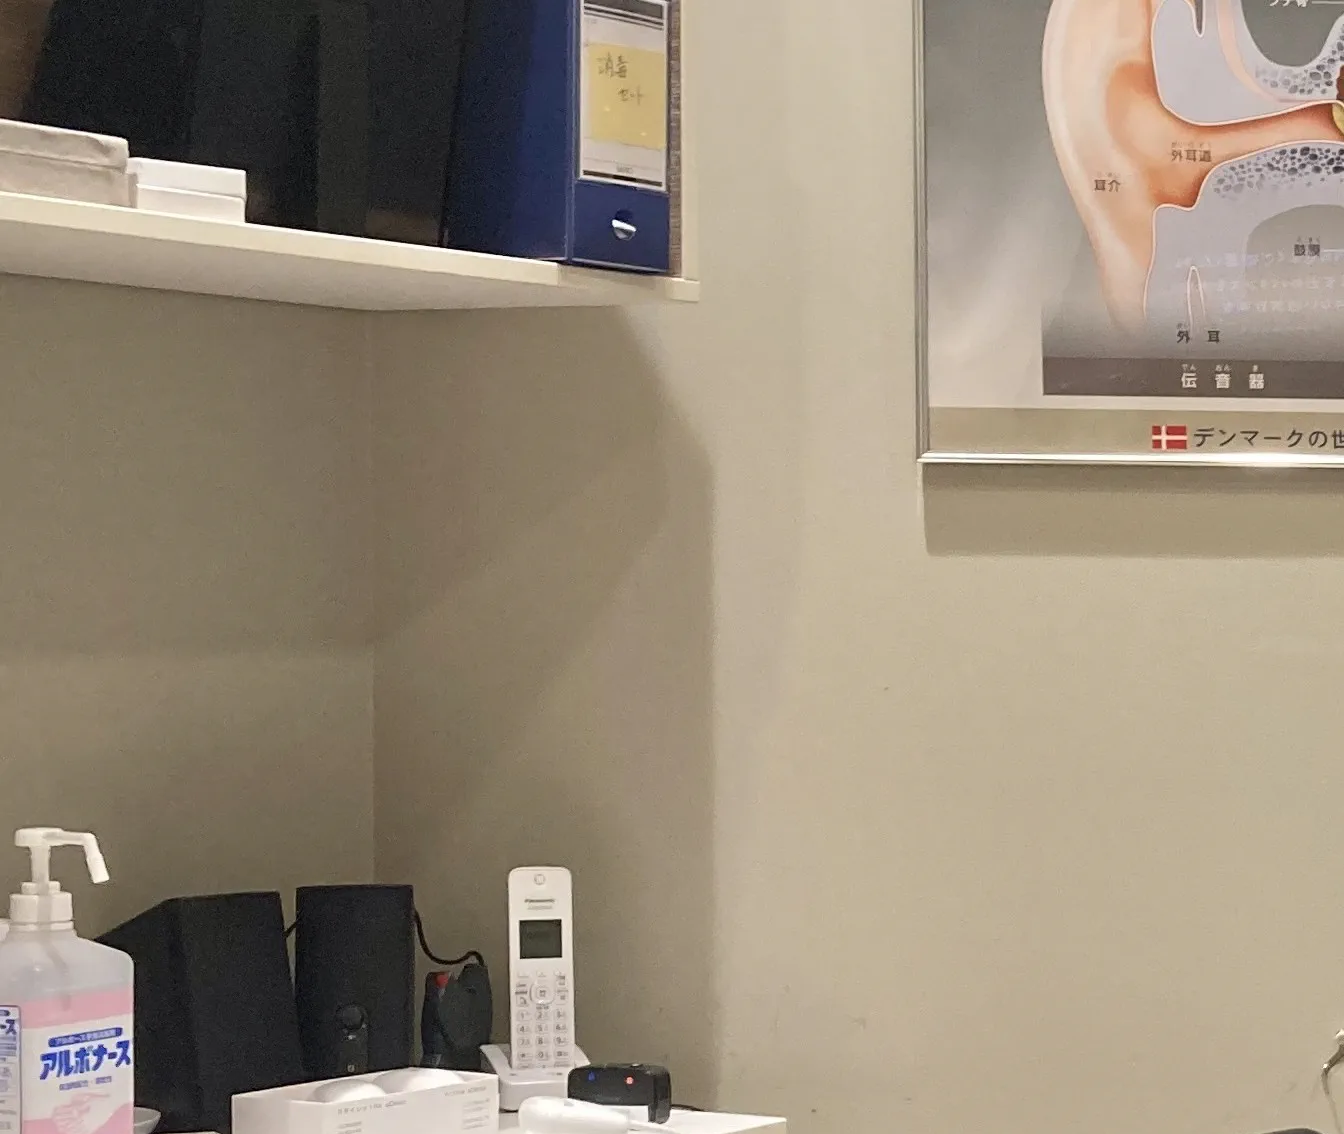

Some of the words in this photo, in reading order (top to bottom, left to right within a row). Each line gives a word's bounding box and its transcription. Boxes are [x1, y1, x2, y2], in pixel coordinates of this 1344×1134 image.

[39, 1039, 132, 1081] アルボナース
